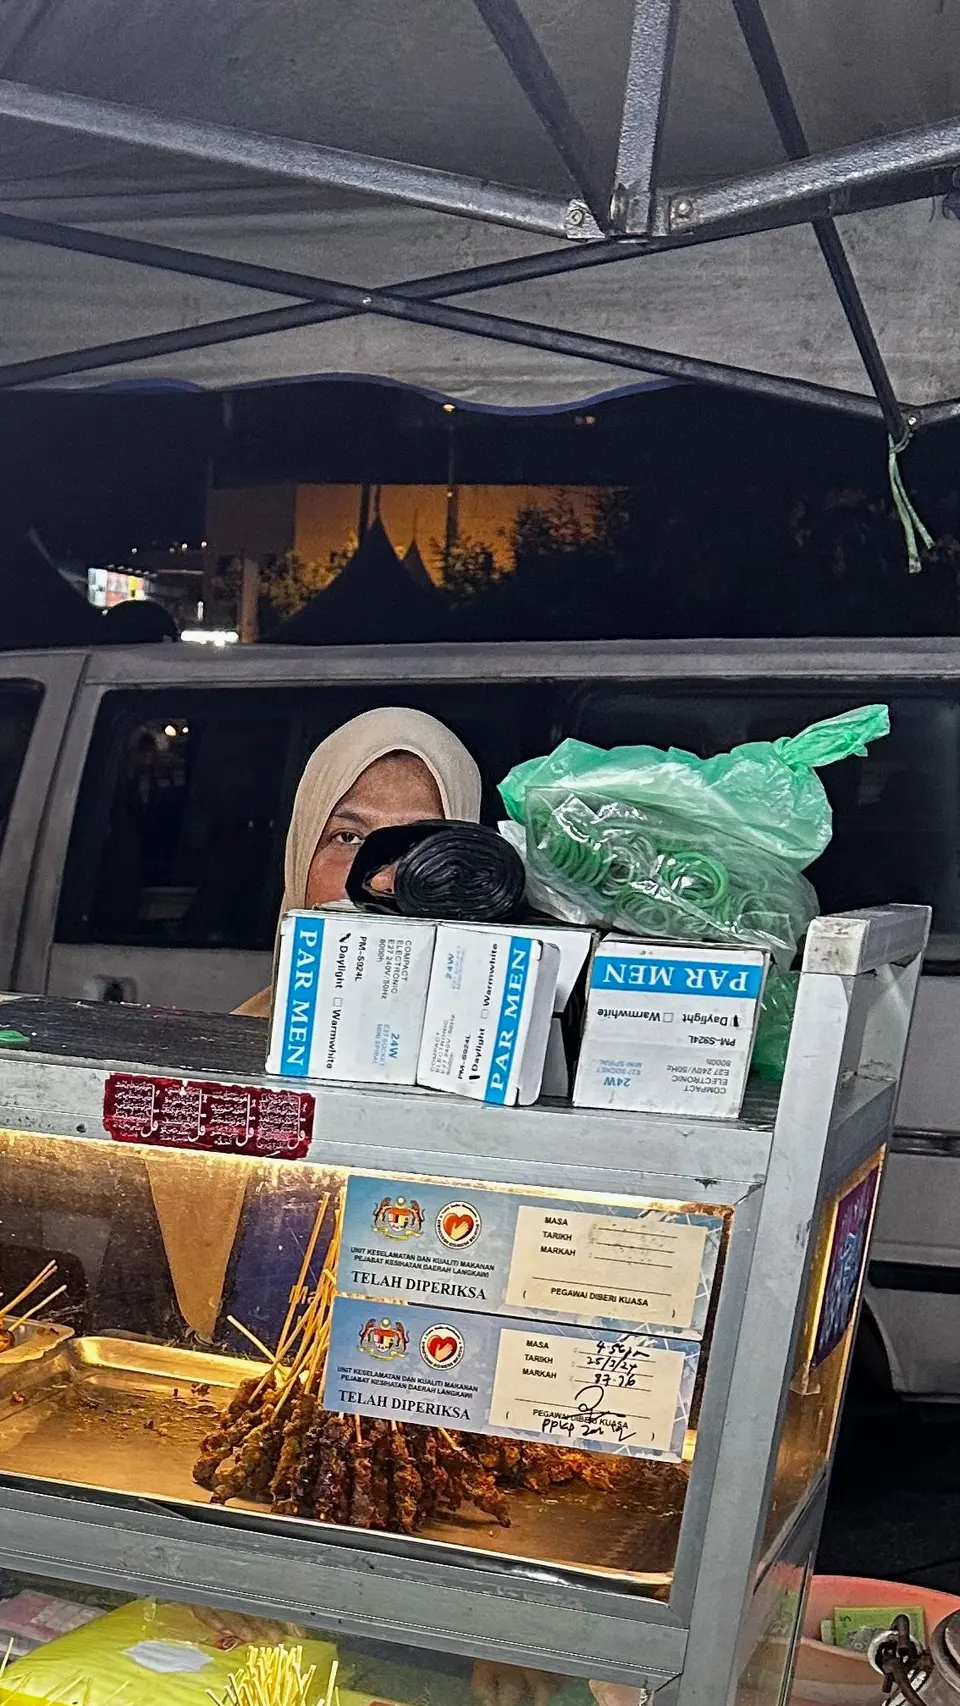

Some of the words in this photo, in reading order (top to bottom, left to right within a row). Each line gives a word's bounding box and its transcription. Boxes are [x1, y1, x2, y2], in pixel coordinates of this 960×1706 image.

[294, 930, 318, 991] PAR
[335, 946, 349, 989] Daylight
[391, 939, 404, 994] ELECTRONIC
[403, 939, 412, 982] COMPACT
[603, 963, 675, 986] MEN
[685, 968, 749, 991] PAR
[471, 1028, 485, 1072] Daylight
[483, 943, 498, 1006] Warmwhite
[597, 1009, 661, 1022] Warmwhite
[490, 1029, 515, 1091] PAR
[504, 949, 527, 1019] MEN
[682, 1013, 728, 1026] Daylight
[286, 1000, 310, 1066] MEN
[326, 1009, 342, 1069] Warmwhite
[390, 1033, 400, 1059] 24W
[603, 1076, 632, 1087] 24W
[671, 1075, 728, 1086] ELECTRONIC
[684, 1085, 727, 1094] COMPACT
[544, 1216, 569, 1227] MASA
[542, 1231, 573, 1241] TARIKH
[540, 1246, 576, 1257] MARKAH
[352, 1270, 403, 1289] TELAH
[406, 1278, 487, 1301] DIPERIKSA
[551, 1287, 588, 1299] PEGAWAI
[589, 1292, 617, 1303] DIBERI
[619, 1296, 649, 1307] KUASA
[526, 1339, 549, 1350] MASA
[524, 1354, 553, 1364] TARIKH
[522, 1368, 557, 1379] MARKAH
[338, 1390, 388, 1408] TELAH
[391, 1398, 471, 1420] DIPERIKSA
